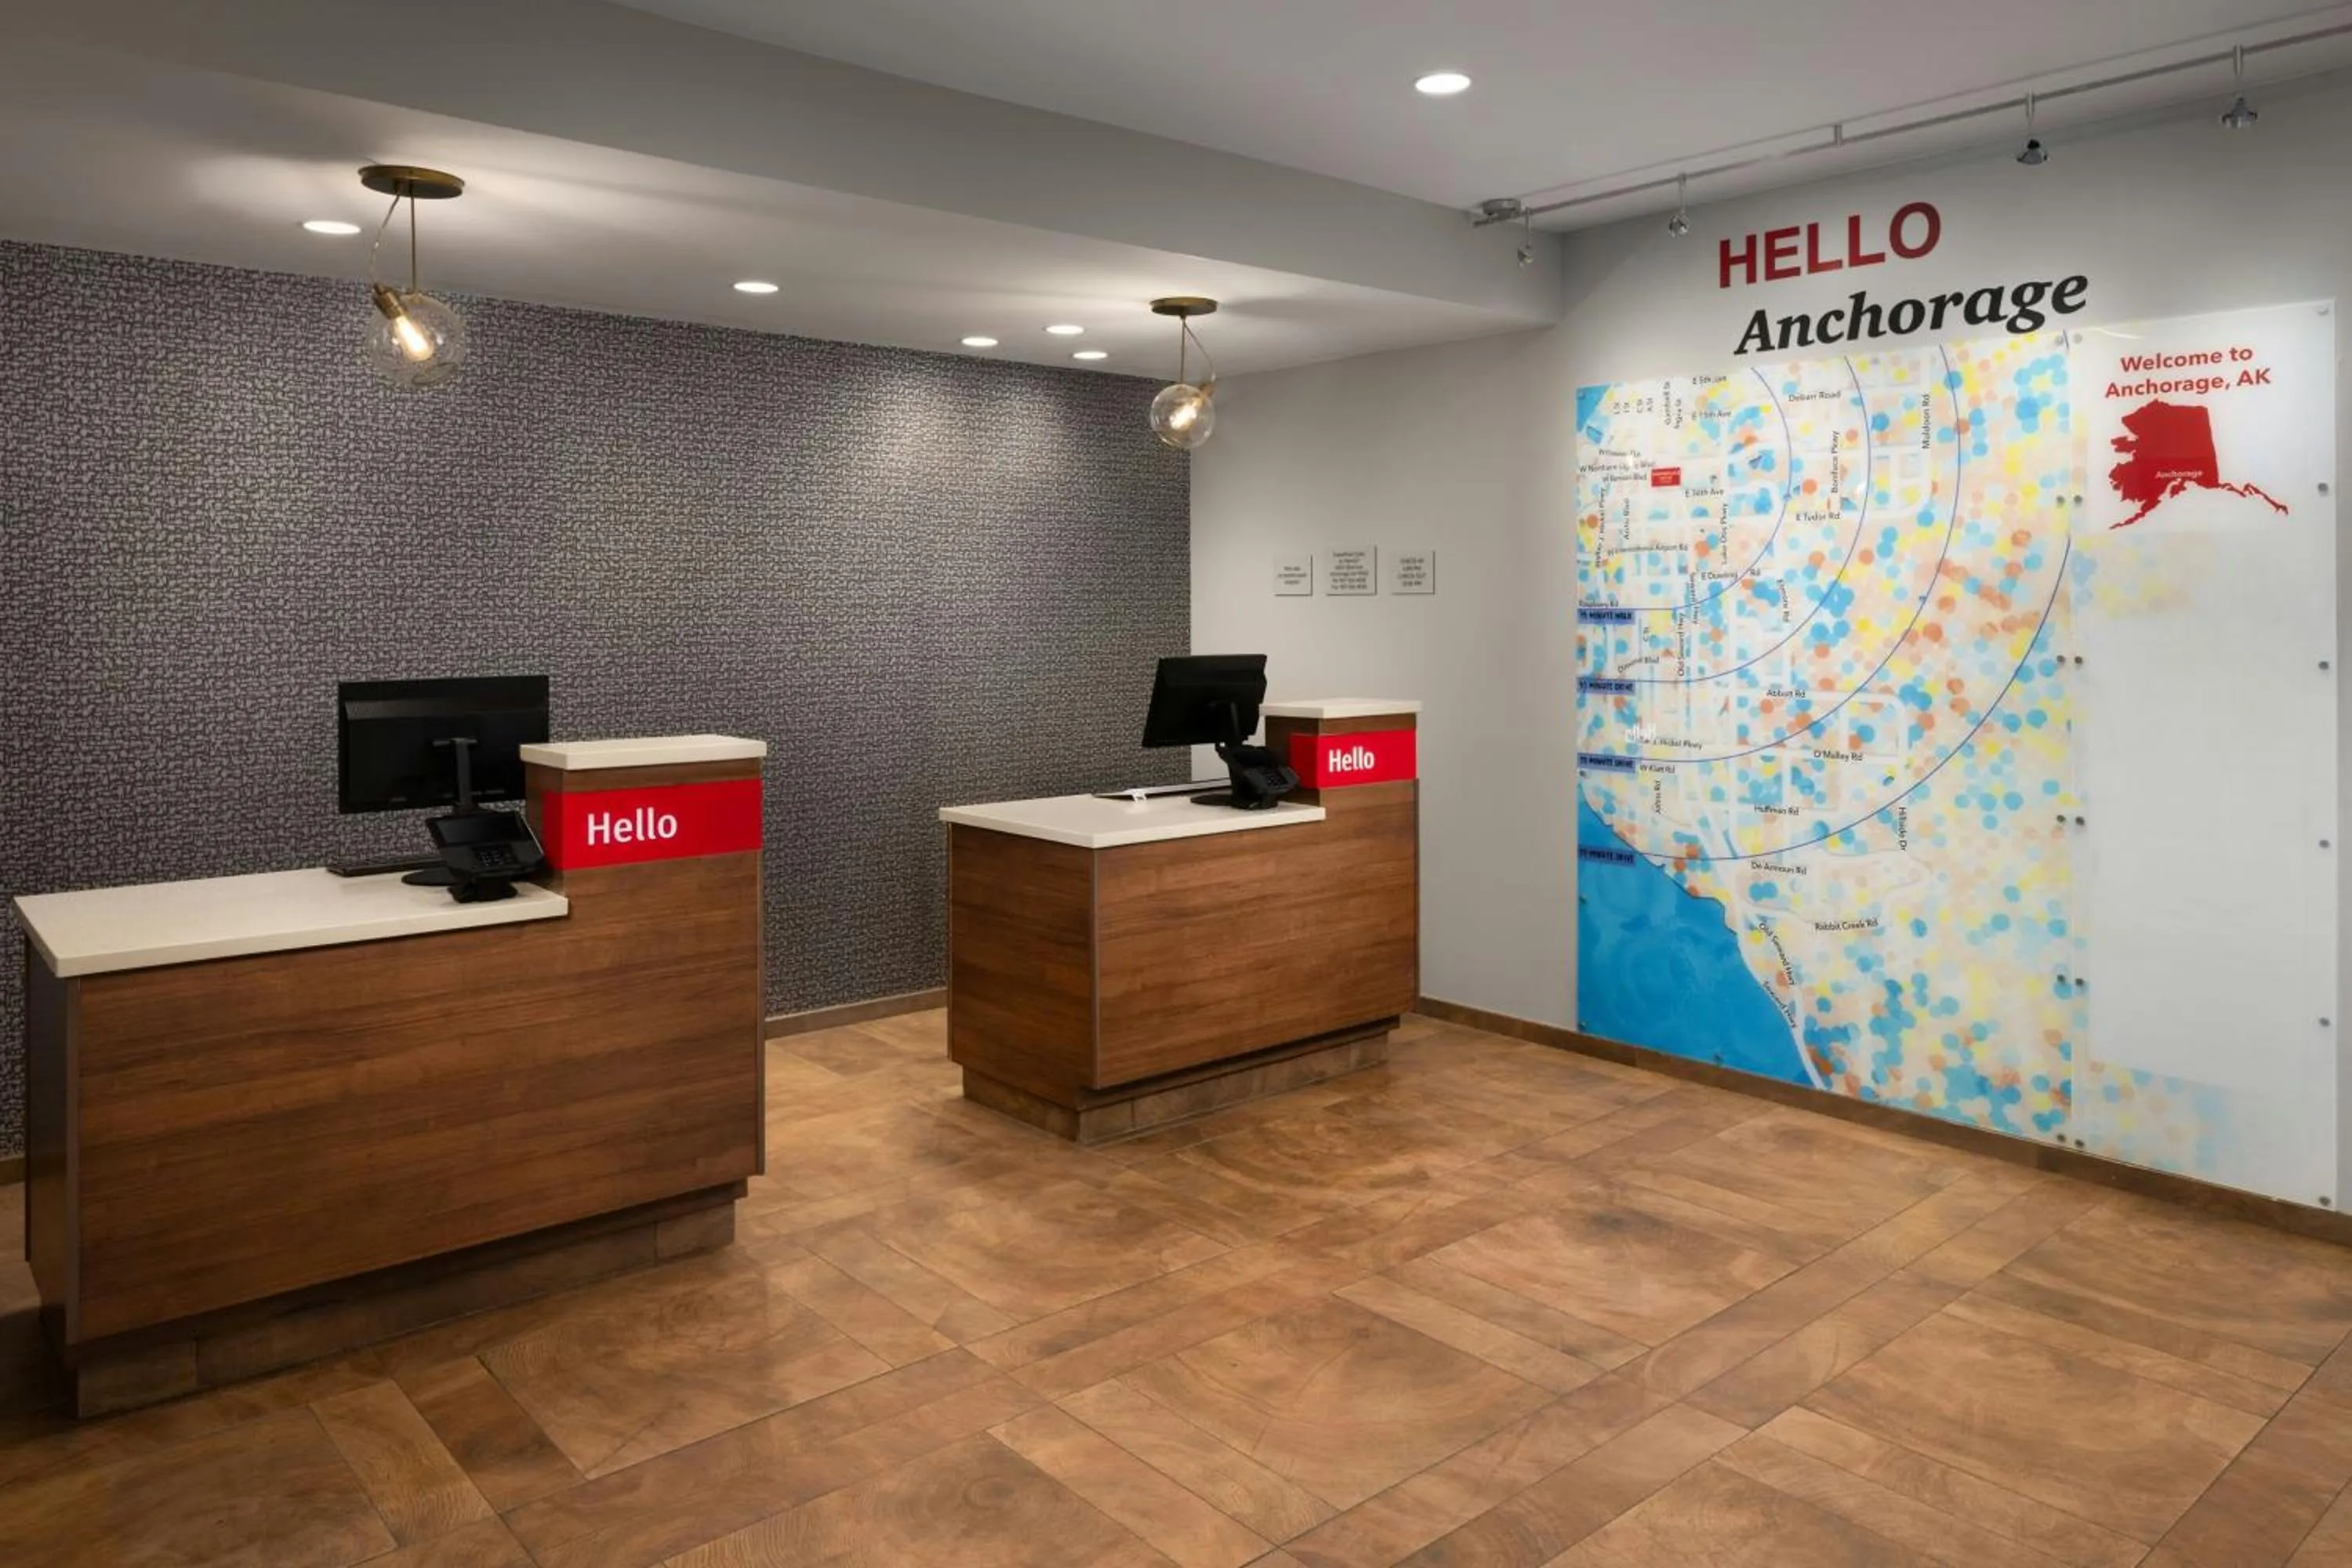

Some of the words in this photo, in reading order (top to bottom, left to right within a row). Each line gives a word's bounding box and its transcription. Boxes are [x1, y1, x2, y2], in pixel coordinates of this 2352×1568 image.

[1719, 201, 1941, 289] HELLO
[1733, 274, 2089, 355] Anchorage
[2121, 351, 2223, 372] Welcome
[2229, 347, 2253, 361] to
[2105, 376, 2230, 398] Anchorage,
[2237, 368, 2271, 386] AK
[2154, 470, 2203, 479] Anchorage
[1328, 746, 1375, 773] Hello
[587, 806, 678, 846] Hello
